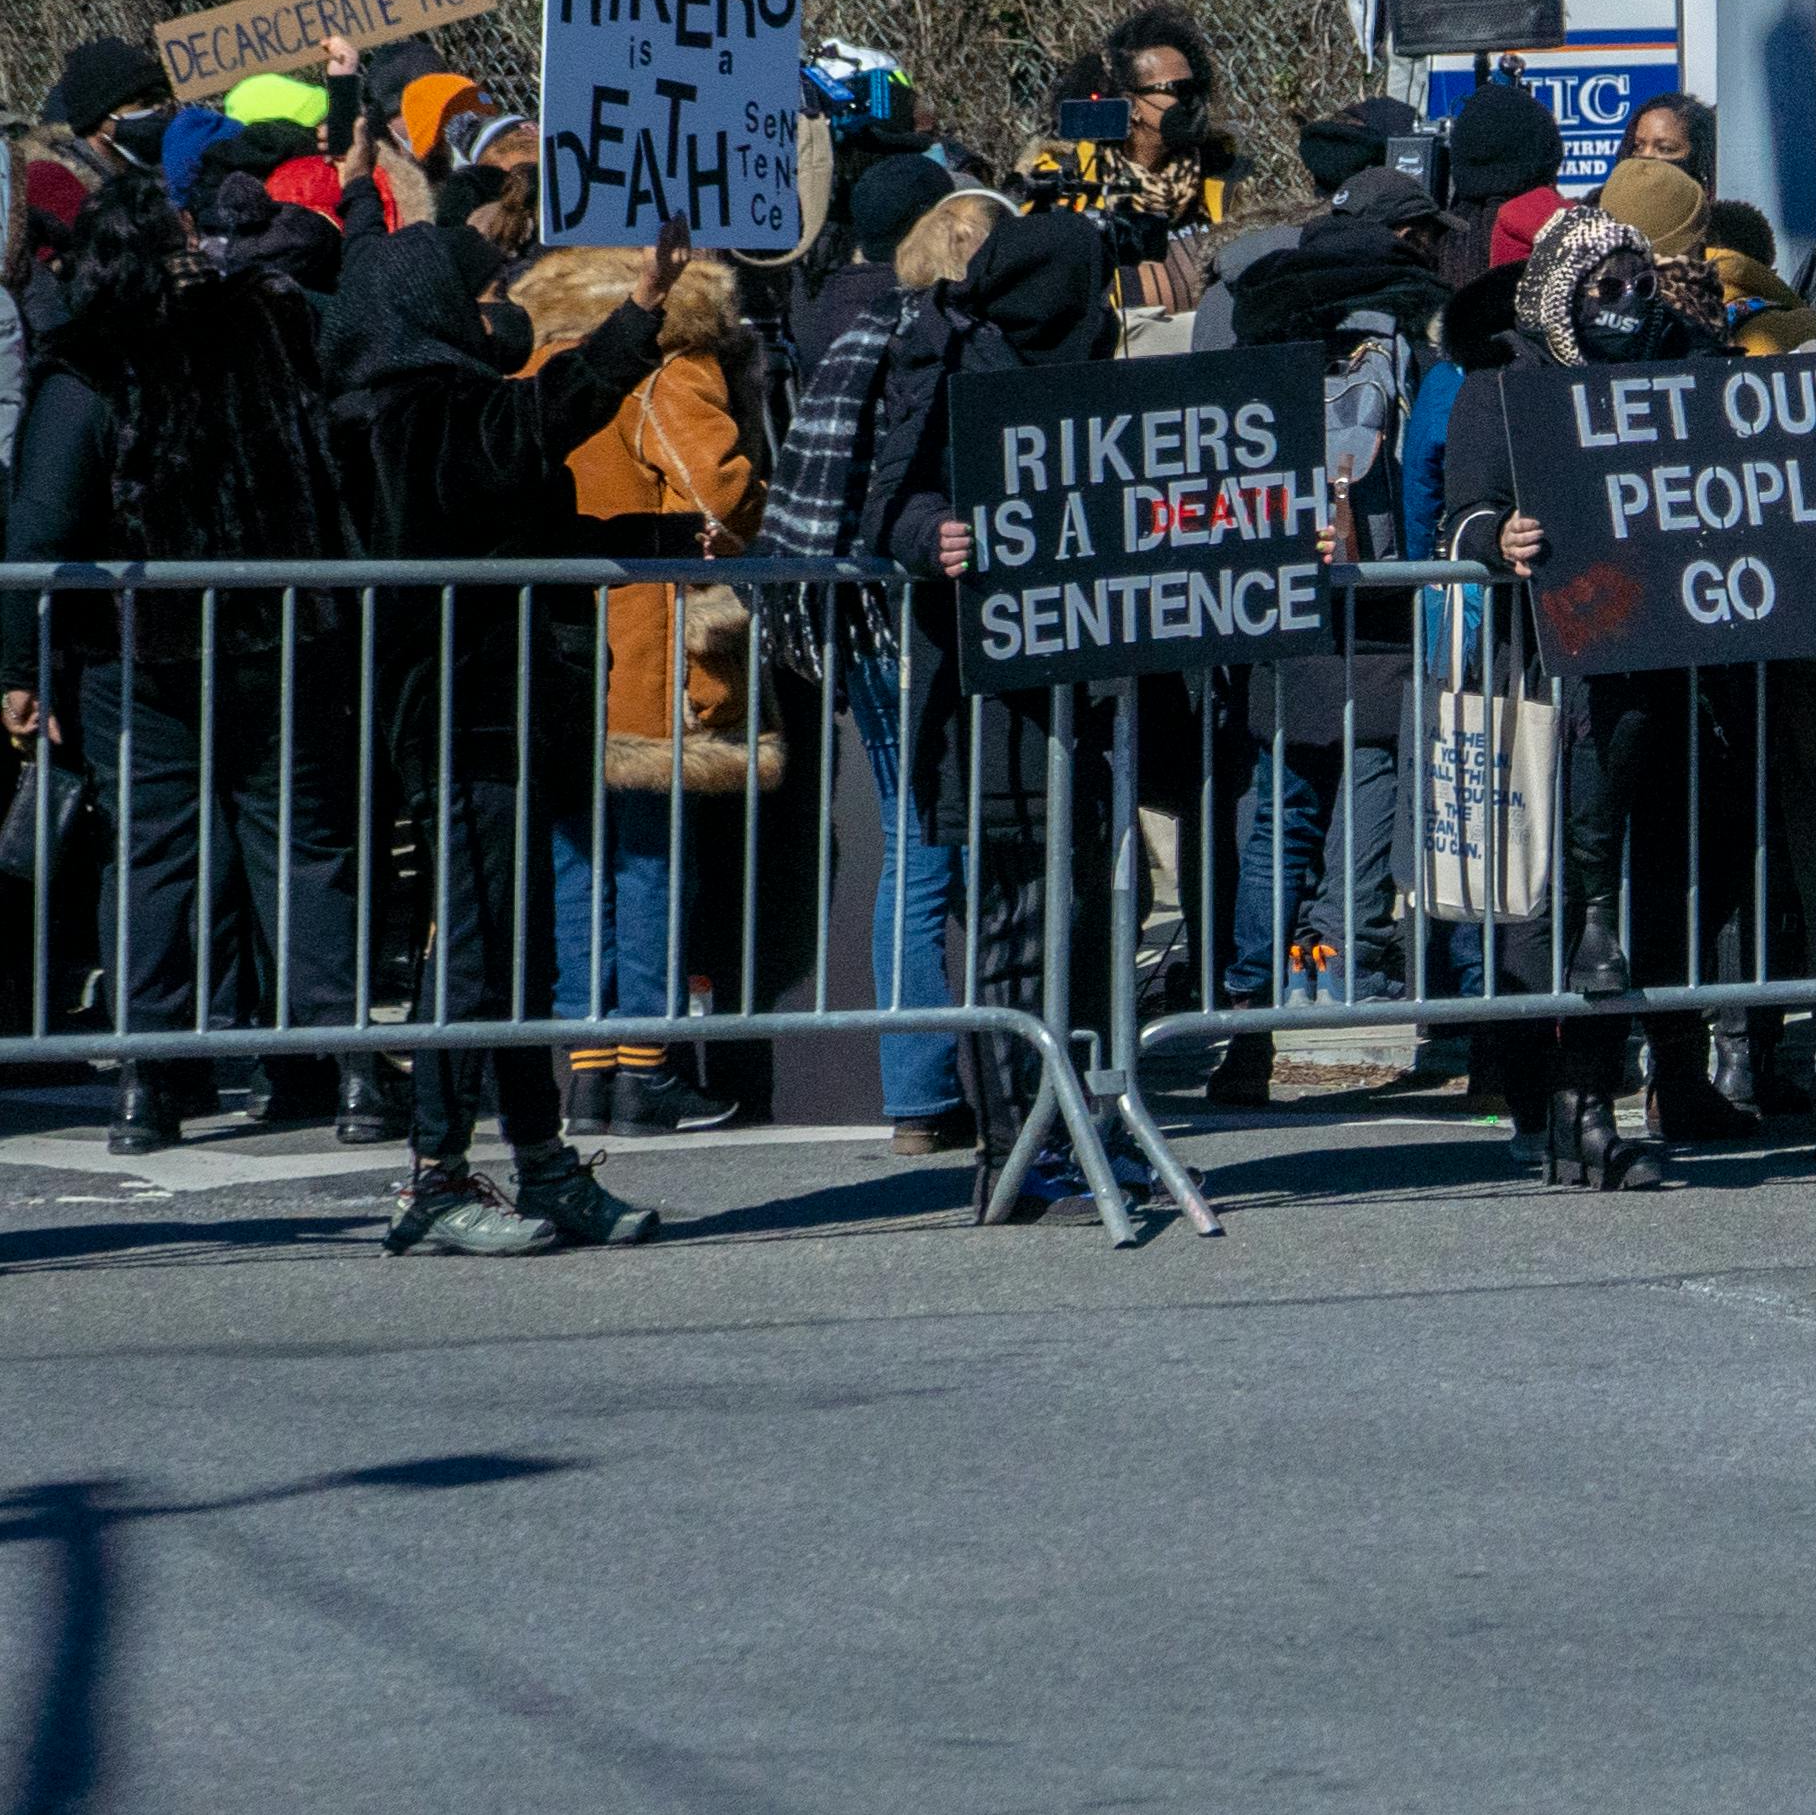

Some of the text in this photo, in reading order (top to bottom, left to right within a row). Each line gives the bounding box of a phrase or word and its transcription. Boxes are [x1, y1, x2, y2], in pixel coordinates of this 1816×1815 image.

[629, 36, 733, 75] is a
[545, 78, 733, 233] DEATH
[752, 193, 782, 231] Ce
[1004, 402, 1278, 495] RIKERS
[1571, 375, 1696, 447] LET
[972, 467, 1329, 573] IS A DEATH
[981, 564, 1321, 661] SENTENCE
[1682, 557, 1775, 625] GO
